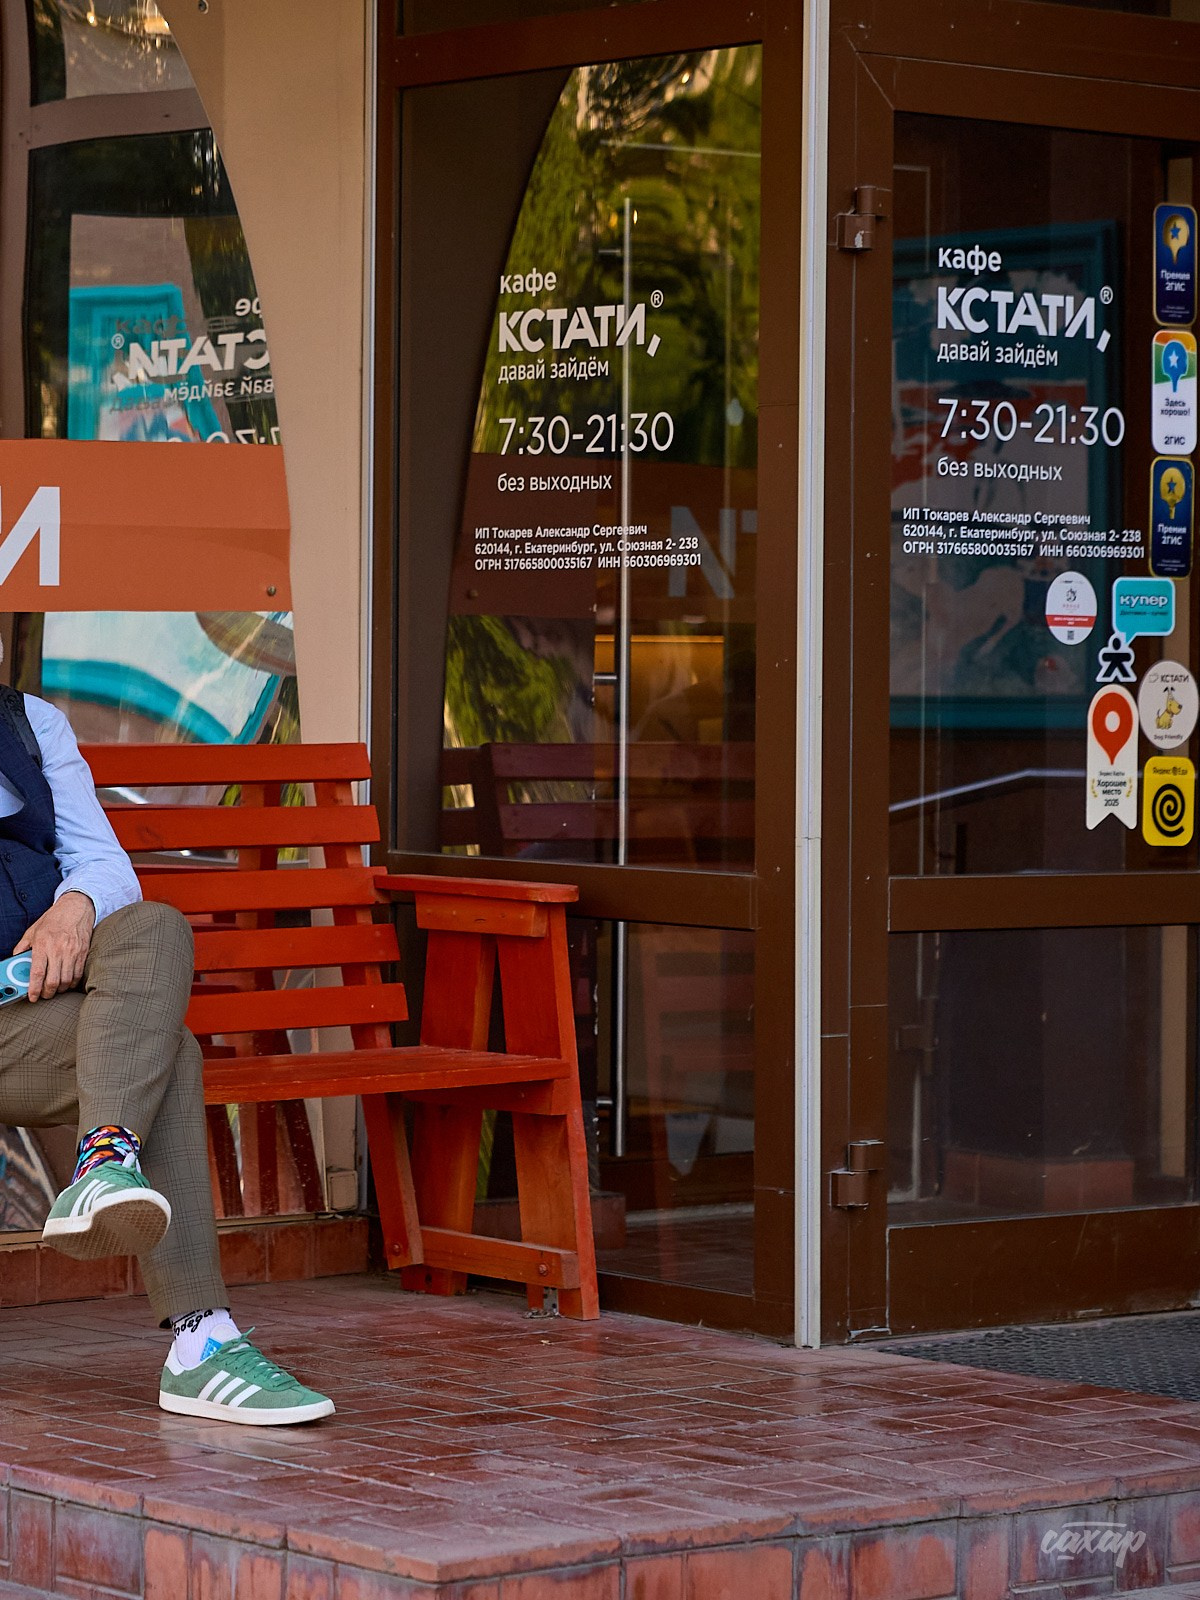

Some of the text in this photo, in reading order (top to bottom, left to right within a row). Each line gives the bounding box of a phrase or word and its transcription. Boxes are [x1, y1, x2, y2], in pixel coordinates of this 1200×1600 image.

[938, 244, 1001, 275] кафе
[500, 267, 557, 297] кафе
[1165, 282, 1186, 292] 2ГИС
[937, 341, 1058, 368] давай зайдём
[498, 356, 609, 384] давай зайдём
[1164, 398, 1186, 407] Здесь
[938, 398, 1125, 446] 7:30-21:30
[499, 411, 674, 455] 7:30-21:30
[1164, 435, 1186, 446] 2ГИС
[937, 456, 1063, 482] без выходных
[497, 473, 612, 493] без выходных
[903, 507, 1091, 526] ИП Токарев Александр Сергеевич
[475, 524, 647, 540] ИП Токарев Александр Сергеевич
[903, 524, 947, 539] 620144,
[949, 528, 957, 538] г.
[960, 526, 1039, 541] Екатеринбург,
[1041, 530, 1057, 542] ул.
[1059, 528, 1106, 541] Союзная
[1121, 529, 1141, 542] 238
[1161, 535, 1183, 546] 2ГИС
[475, 543, 512, 556] 620144,
[514, 545, 522, 554] г.
[524, 541, 597, 555] Екатеринбург,
[599, 543, 615, 554] ул.
[617, 540, 663, 552] Союзная
[678, 537, 699, 550] 238
[903, 541, 1145, 558] ОГРН 317665800035167 ИНН 660306969301
[475, 553, 701, 570] ОГРН 317665800035167 ИНН 660306969301
[1120, 595, 1168, 608] купер
[1160, 674, 1189, 683] КСТАТИ
[1096, 779, 1127, 788] Хорошее
